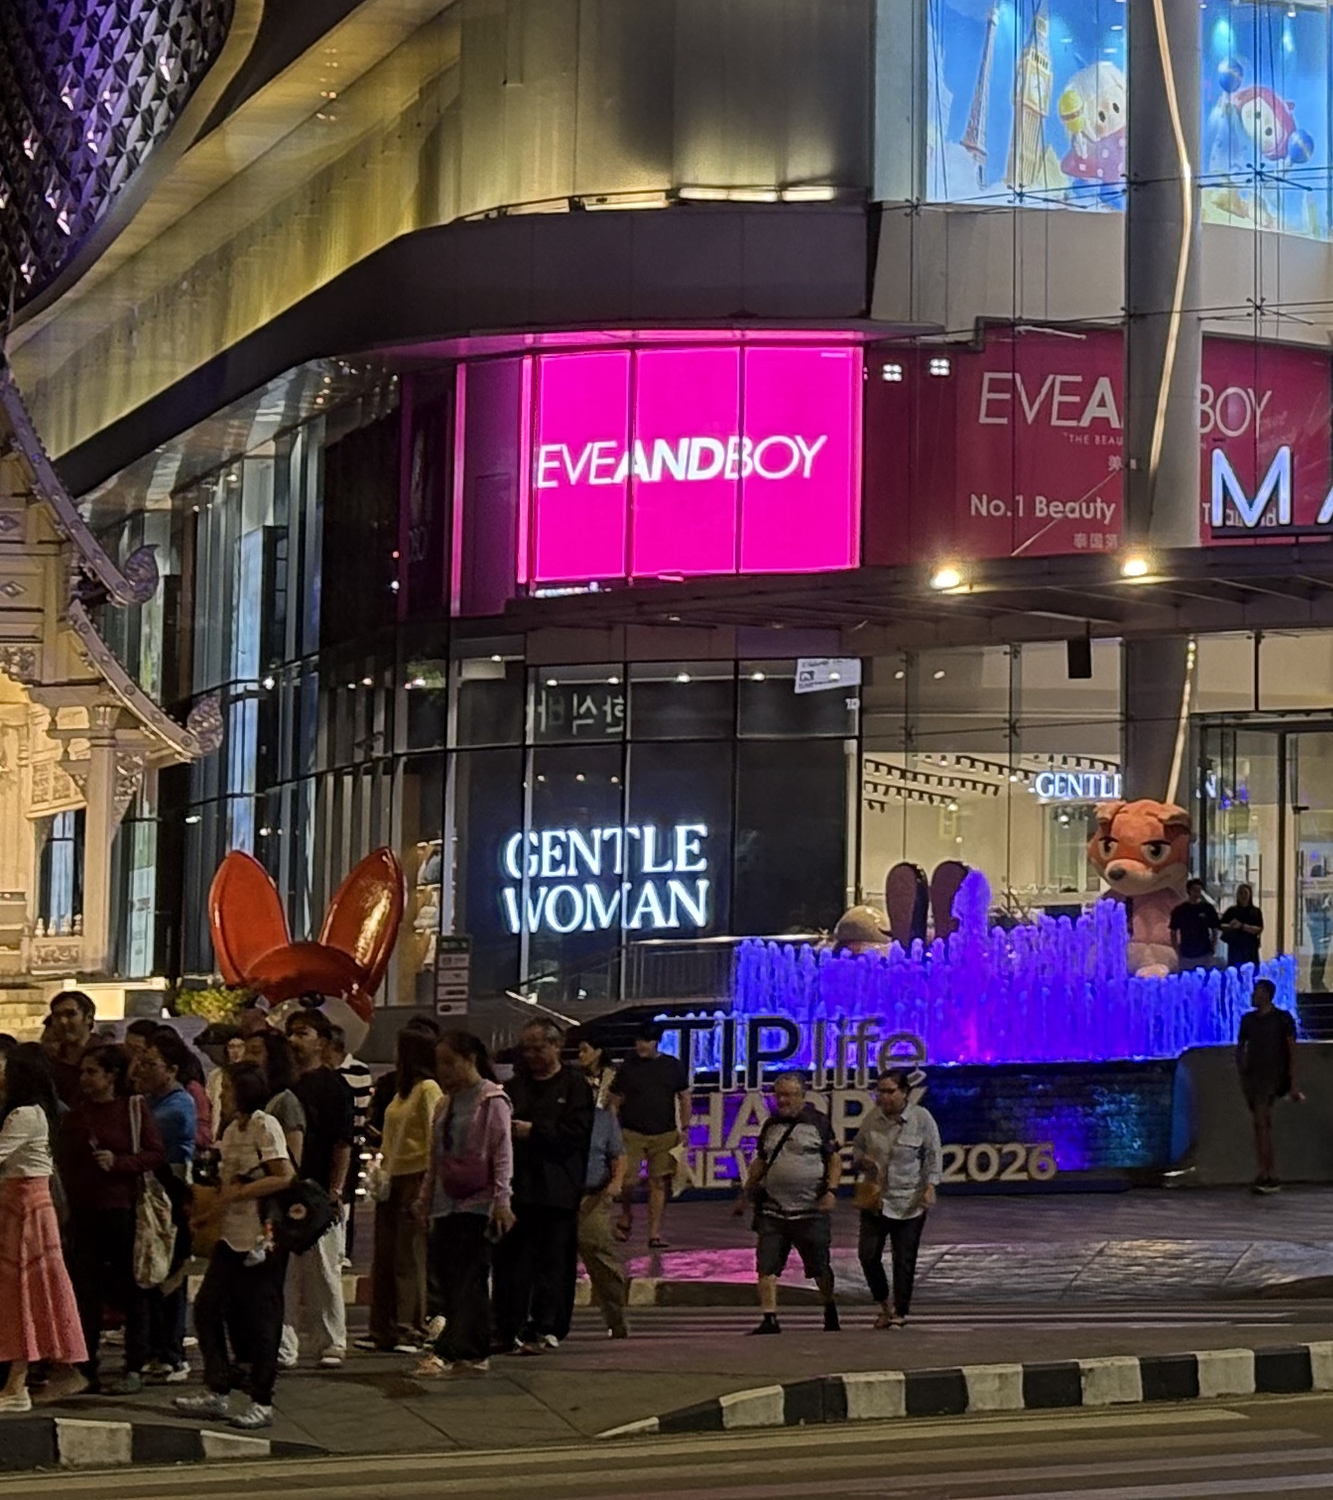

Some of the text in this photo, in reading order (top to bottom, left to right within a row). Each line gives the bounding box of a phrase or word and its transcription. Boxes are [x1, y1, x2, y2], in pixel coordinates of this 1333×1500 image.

[537, 435, 828, 489] EVEANDBOY
[970, 494, 1025, 518] No.1
[1034, 494, 1117, 525] Beauty
[504, 824, 709, 880] GENTLE
[502, 878, 709, 934] WOMAN
[940, 1143, 1058, 1184] 2026
